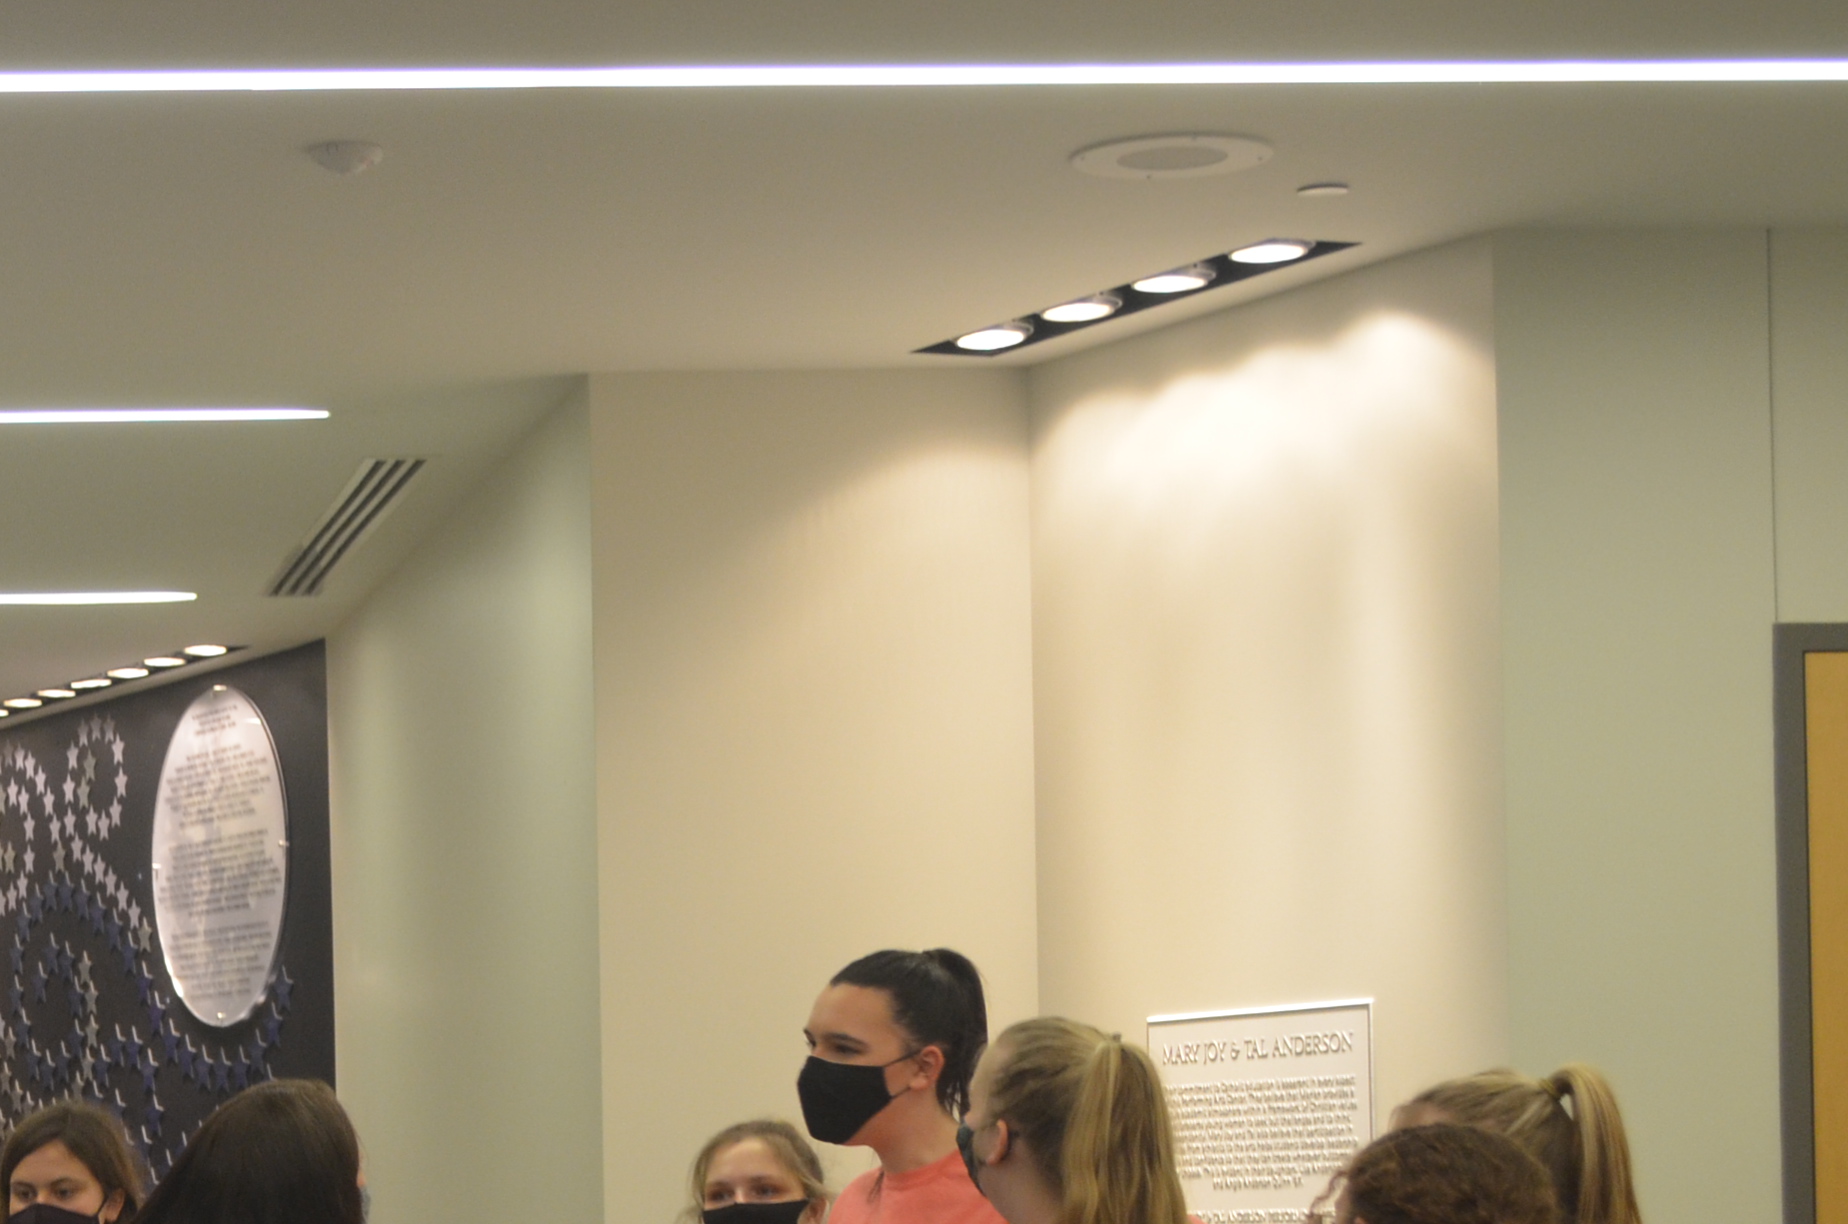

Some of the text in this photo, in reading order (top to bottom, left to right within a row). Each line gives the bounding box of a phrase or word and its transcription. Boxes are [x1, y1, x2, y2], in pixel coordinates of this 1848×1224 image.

[1163, 1030, 1354, 1065] MARY JOY & TAL ANDERSON
